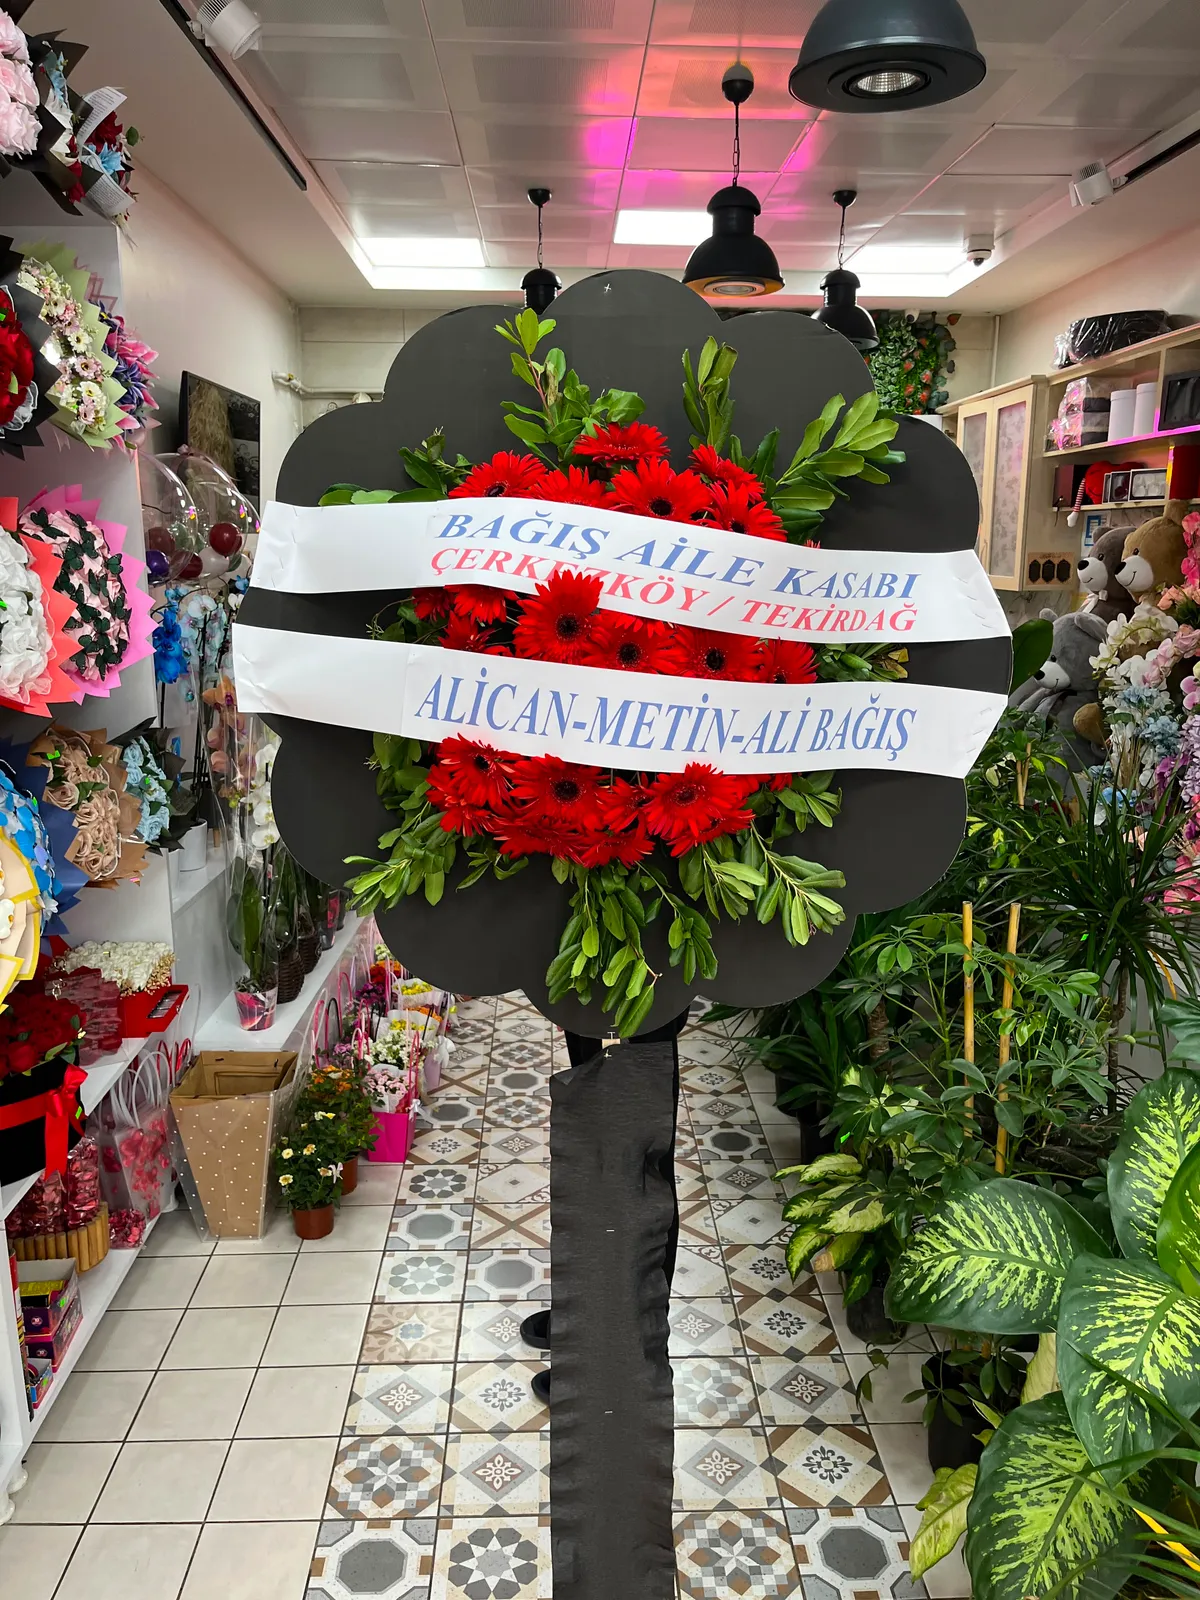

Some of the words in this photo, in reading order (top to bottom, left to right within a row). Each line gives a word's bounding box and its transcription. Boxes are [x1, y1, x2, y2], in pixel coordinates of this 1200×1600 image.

[436, 509, 611, 560] BAĞIŞ
[613, 536, 765, 587] AİLE
[771, 566, 922, 599] KASABI
[707, 595, 735, 616] /
[738, 602, 919, 632] TEKİRDAĞ
[414, 666, 813, 755] ALİCAN-METİN-ALİ
[806, 692, 917, 762] BAĞIŞ
